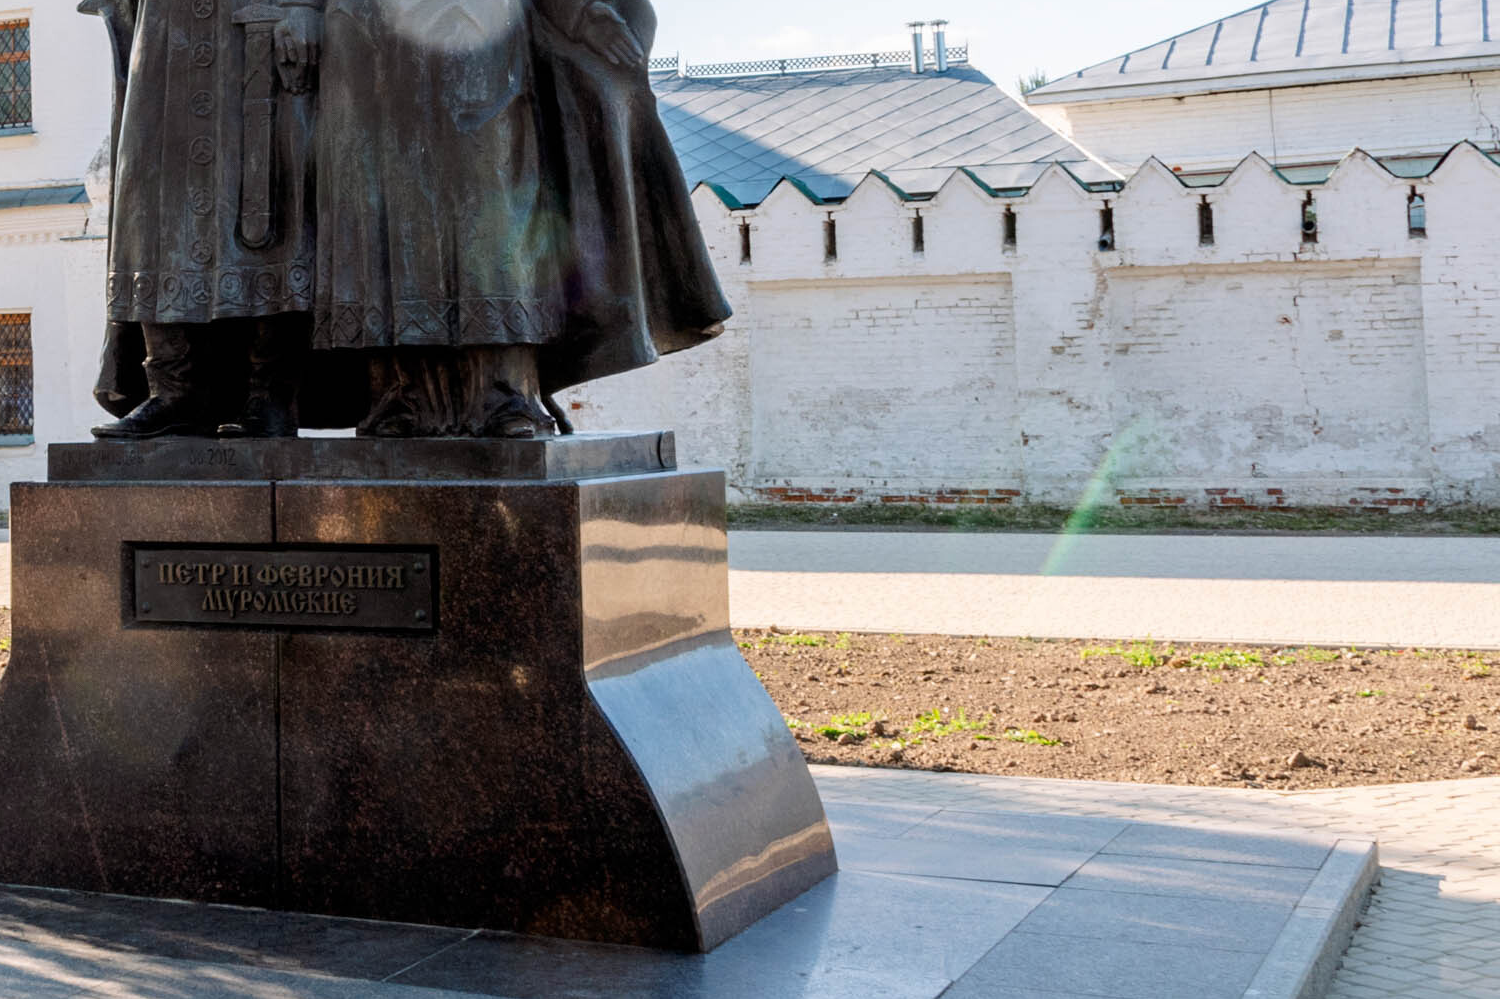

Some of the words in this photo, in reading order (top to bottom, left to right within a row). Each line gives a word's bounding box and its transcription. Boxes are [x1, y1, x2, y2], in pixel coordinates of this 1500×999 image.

[158, 562, 226, 585] ПЕТР
[232, 563, 251, 587] И
[255, 564, 406, 589] ФЕВРОНИЯ
[201, 588, 357, 617] МУРОМСКИЕ
